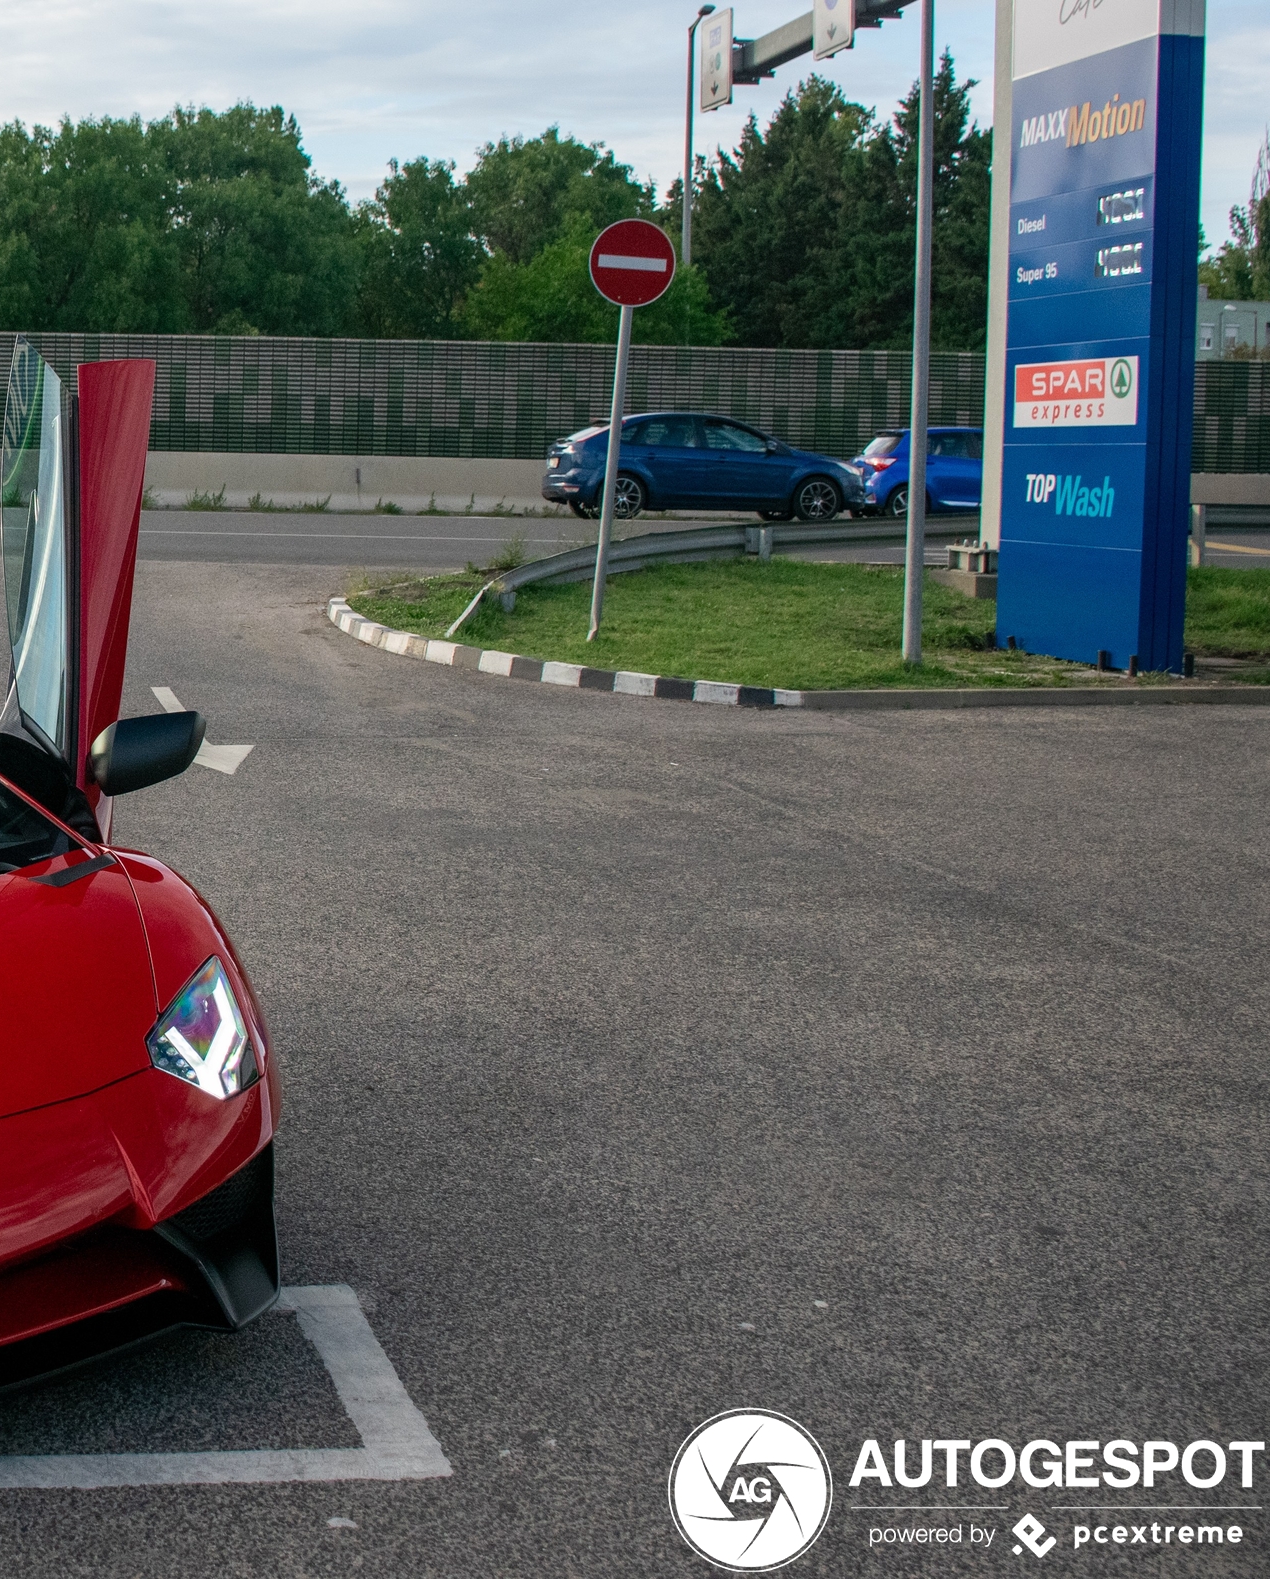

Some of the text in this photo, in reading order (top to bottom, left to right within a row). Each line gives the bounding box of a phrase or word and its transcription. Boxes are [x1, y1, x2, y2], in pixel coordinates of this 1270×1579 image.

[1017, 214, 1046, 235] Diesel
[1016, 262, 1058, 285] Super 95
[1032, 369, 1103, 396] SPAR
[1031, 402, 1105, 423] express
